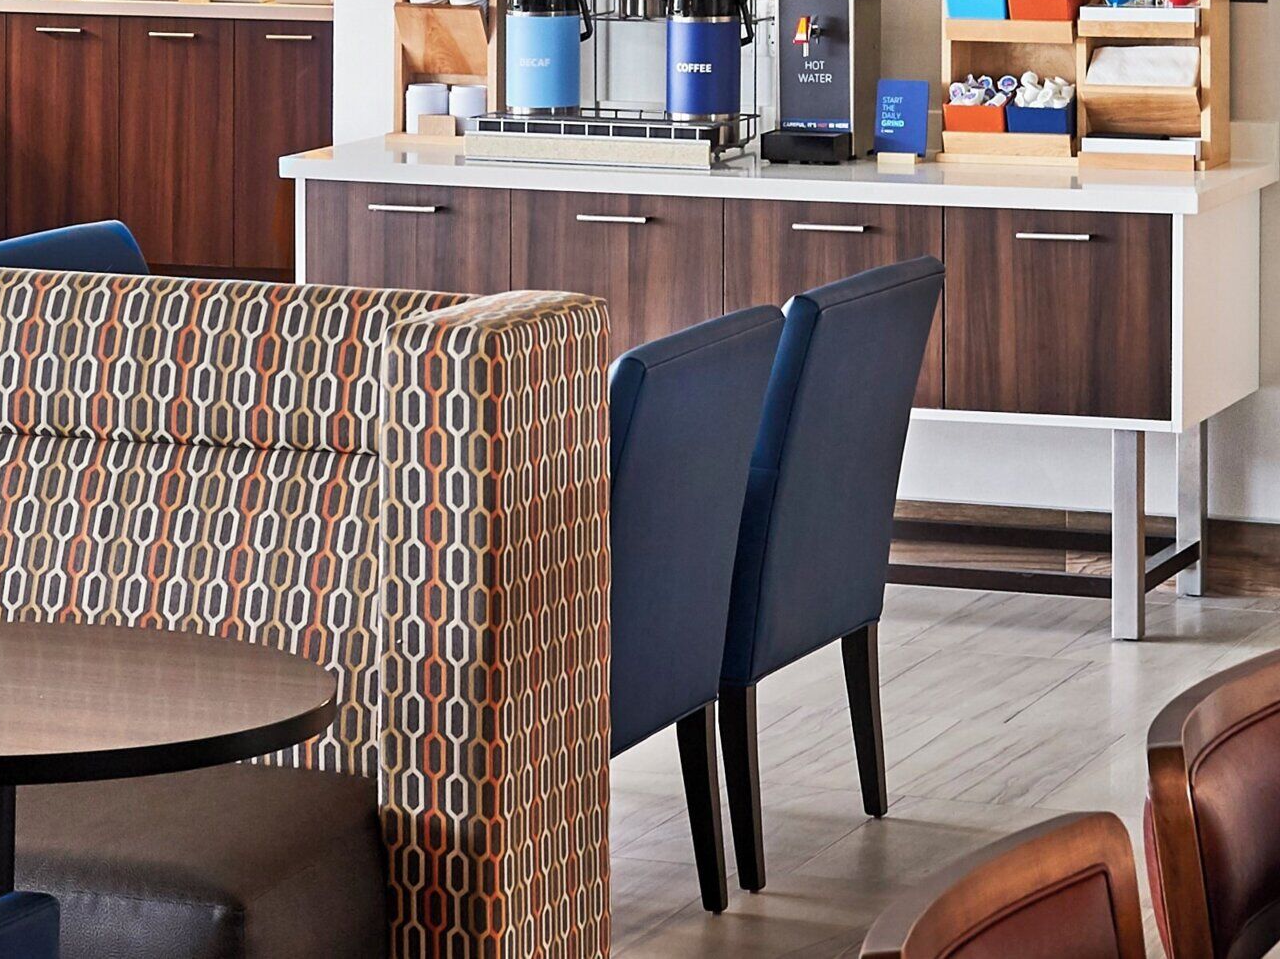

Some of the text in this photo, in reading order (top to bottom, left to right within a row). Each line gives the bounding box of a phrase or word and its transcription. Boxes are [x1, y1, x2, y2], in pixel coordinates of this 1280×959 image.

[519, 58, 551, 67] DECAF
[676, 62, 712, 73] COFFEE
[804, 60, 825, 70] HOT
[798, 73, 832, 83] WATER
[881, 119, 904, 127] GRIND
